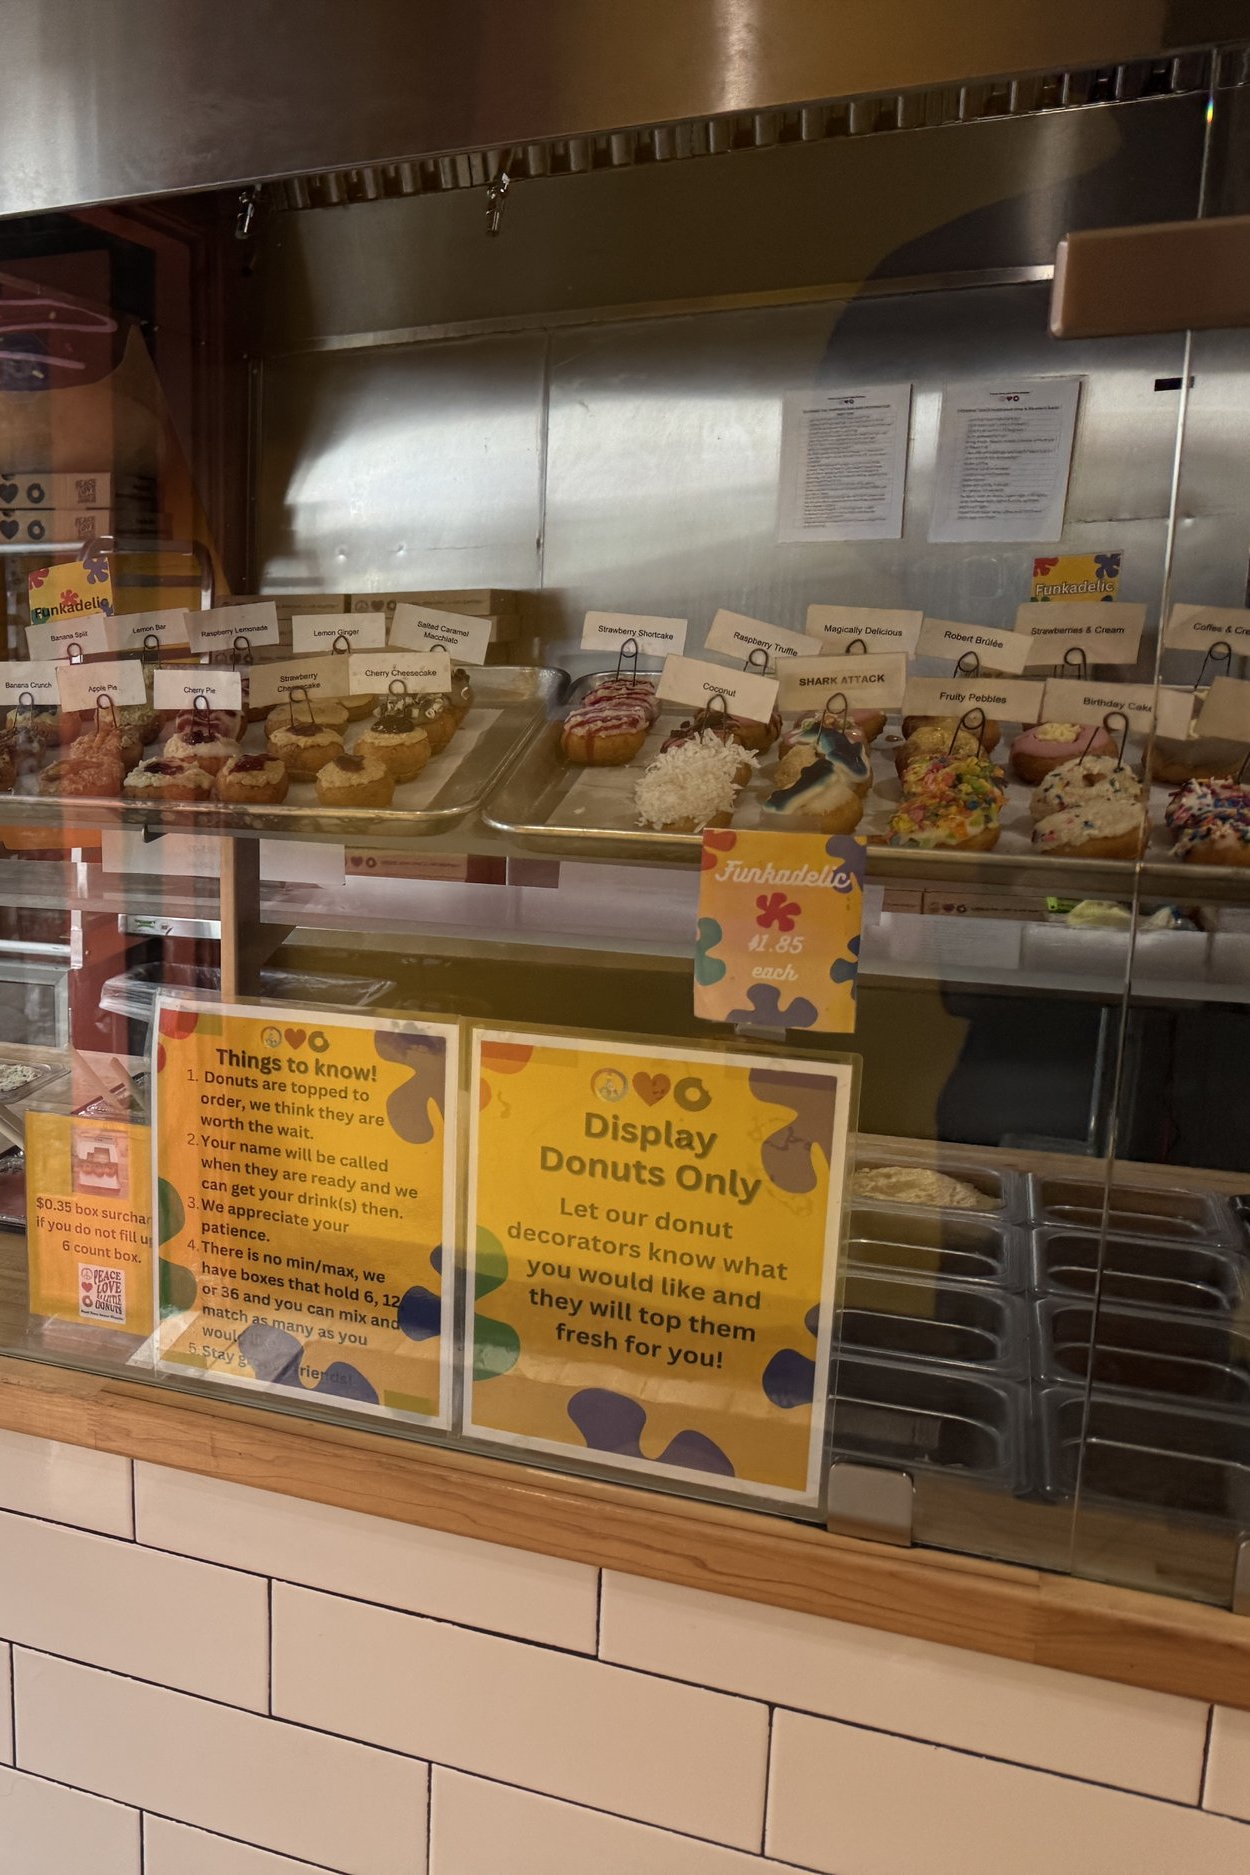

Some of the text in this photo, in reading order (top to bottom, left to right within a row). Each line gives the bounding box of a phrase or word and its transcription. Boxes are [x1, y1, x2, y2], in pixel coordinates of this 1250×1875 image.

[1035, 580, 1114, 596] Funkadelic
[33, 597, 108, 620] Funkadelic
[51, 630, 89, 642] Banana Split
[132, 623, 167, 634] Lemon Bar
[201, 624, 268, 638] Raspberry Lemonade
[337, 628, 360, 639] Ginger
[417, 621, 470, 638] Salted Caramel
[598, 625, 674, 640] Strawberry Shortcake
[824, 625, 903, 637] Magically Delicious
[1031, 626, 1125, 635] Strawberries & Cream
[1193, 623, 1232, 634] Coffee &
[423, 633, 459, 645] Macchiato
[733, 632, 798, 657] Raspberry Truffle
[944, 631, 973, 644] Robert
[280, 673, 319, 684] Strawberry
[365, 668, 438, 679] Cherry Cheesecake
[799, 674, 885, 687] SHARK ATTACK
[5, 680, 53, 690] Banana Crunch
[88, 683, 118, 694] Apple Pie
[183, 686, 216, 697] Cherry Pie
[702, 681, 737, 698] Coconut
[939, 691, 1007, 704] Fruity Pebbles
[1083, 697, 1124, 711] Birthday
[715, 860, 850, 889] Funkadelic
[748, 934, 805, 954] $1.85
[752, 964, 798, 981] each
[216, 1048, 378, 1082] Things to know!
[187, 1069, 370, 1102] 1. Donuts are topped to
[201, 1094, 385, 1126] order, we think they are
[201, 1114, 314, 1140] worth the wait.
[584, 1111, 718, 1159] Display
[539, 1145, 762, 1206] Donuts Only
[36, 1196, 99, 1217] $0.35 box
[559, 1197, 734, 1240] Let our donut
[36, 1216, 138, 1244] if you do not fill
[62, 1240, 142, 1264] 6 count box.
[507, 1222, 789, 1281] decorators know what
[94, 1269, 121, 1285] PEACE
[97, 1281, 121, 1294] LOVE
